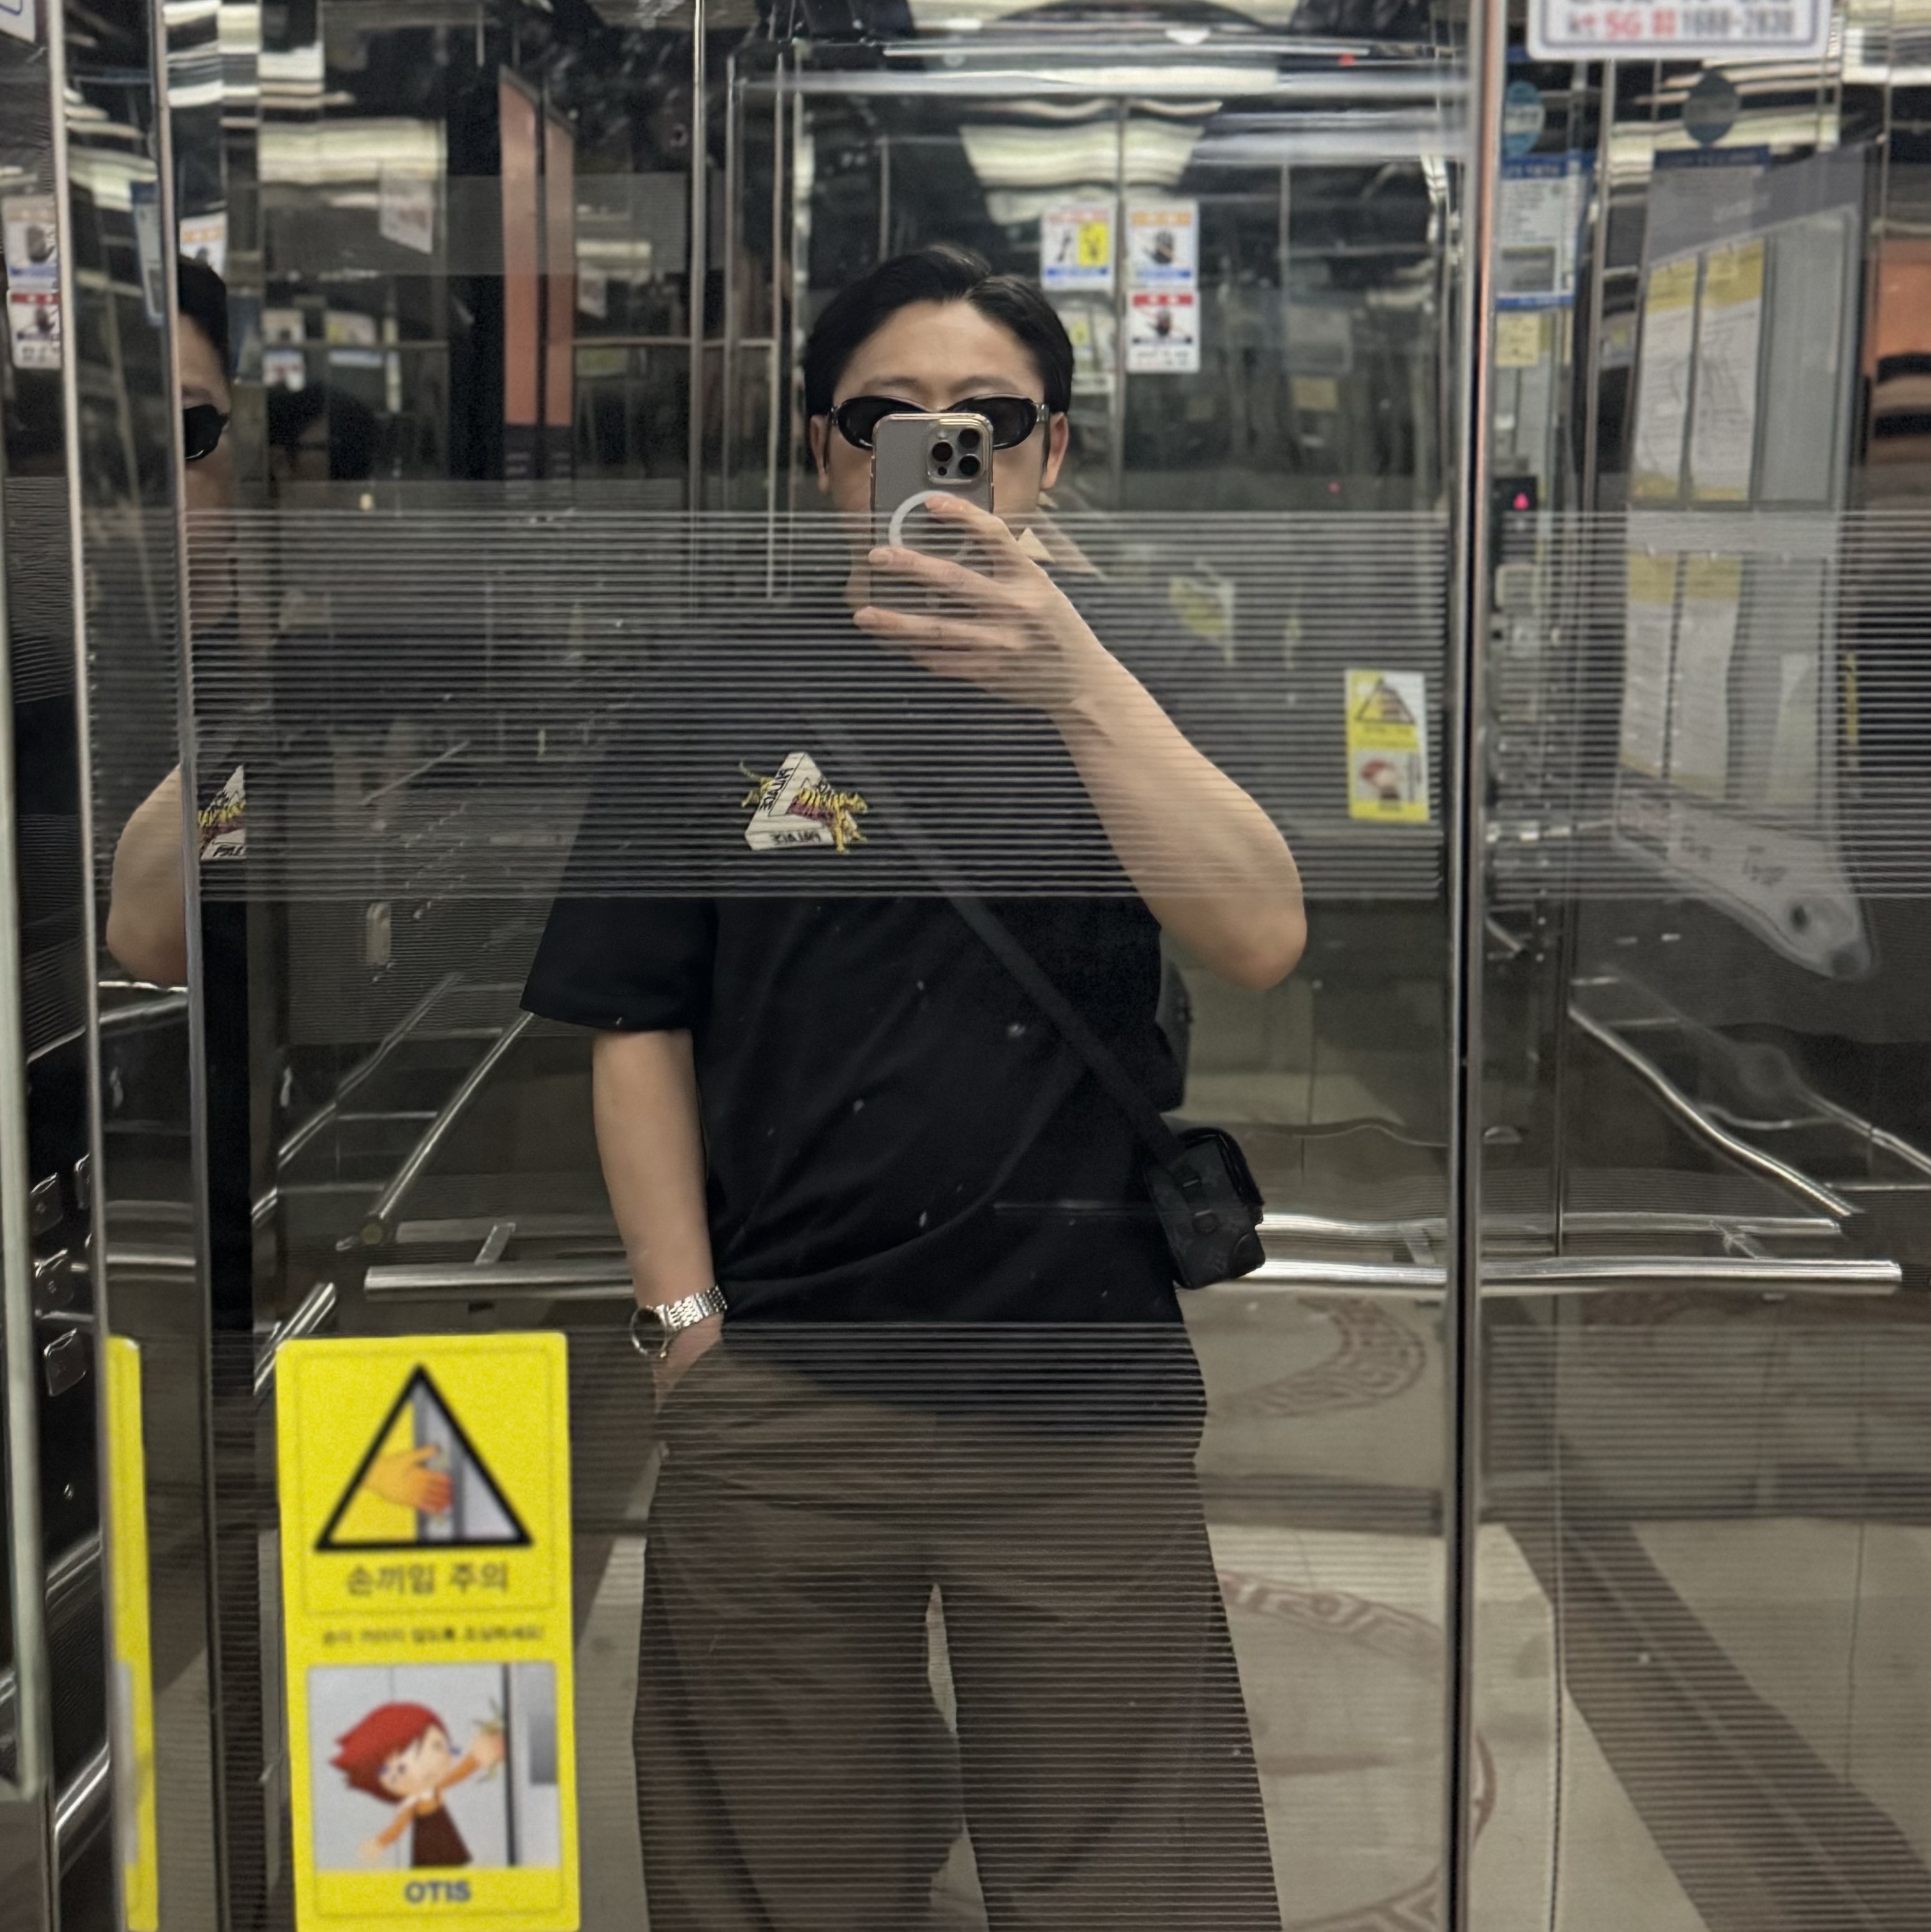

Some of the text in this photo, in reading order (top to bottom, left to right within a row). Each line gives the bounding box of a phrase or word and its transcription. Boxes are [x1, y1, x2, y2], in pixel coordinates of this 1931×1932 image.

[346, 1562, 508, 1596] 손끼임 주의
[404, 1880, 472, 1904] OTIS
